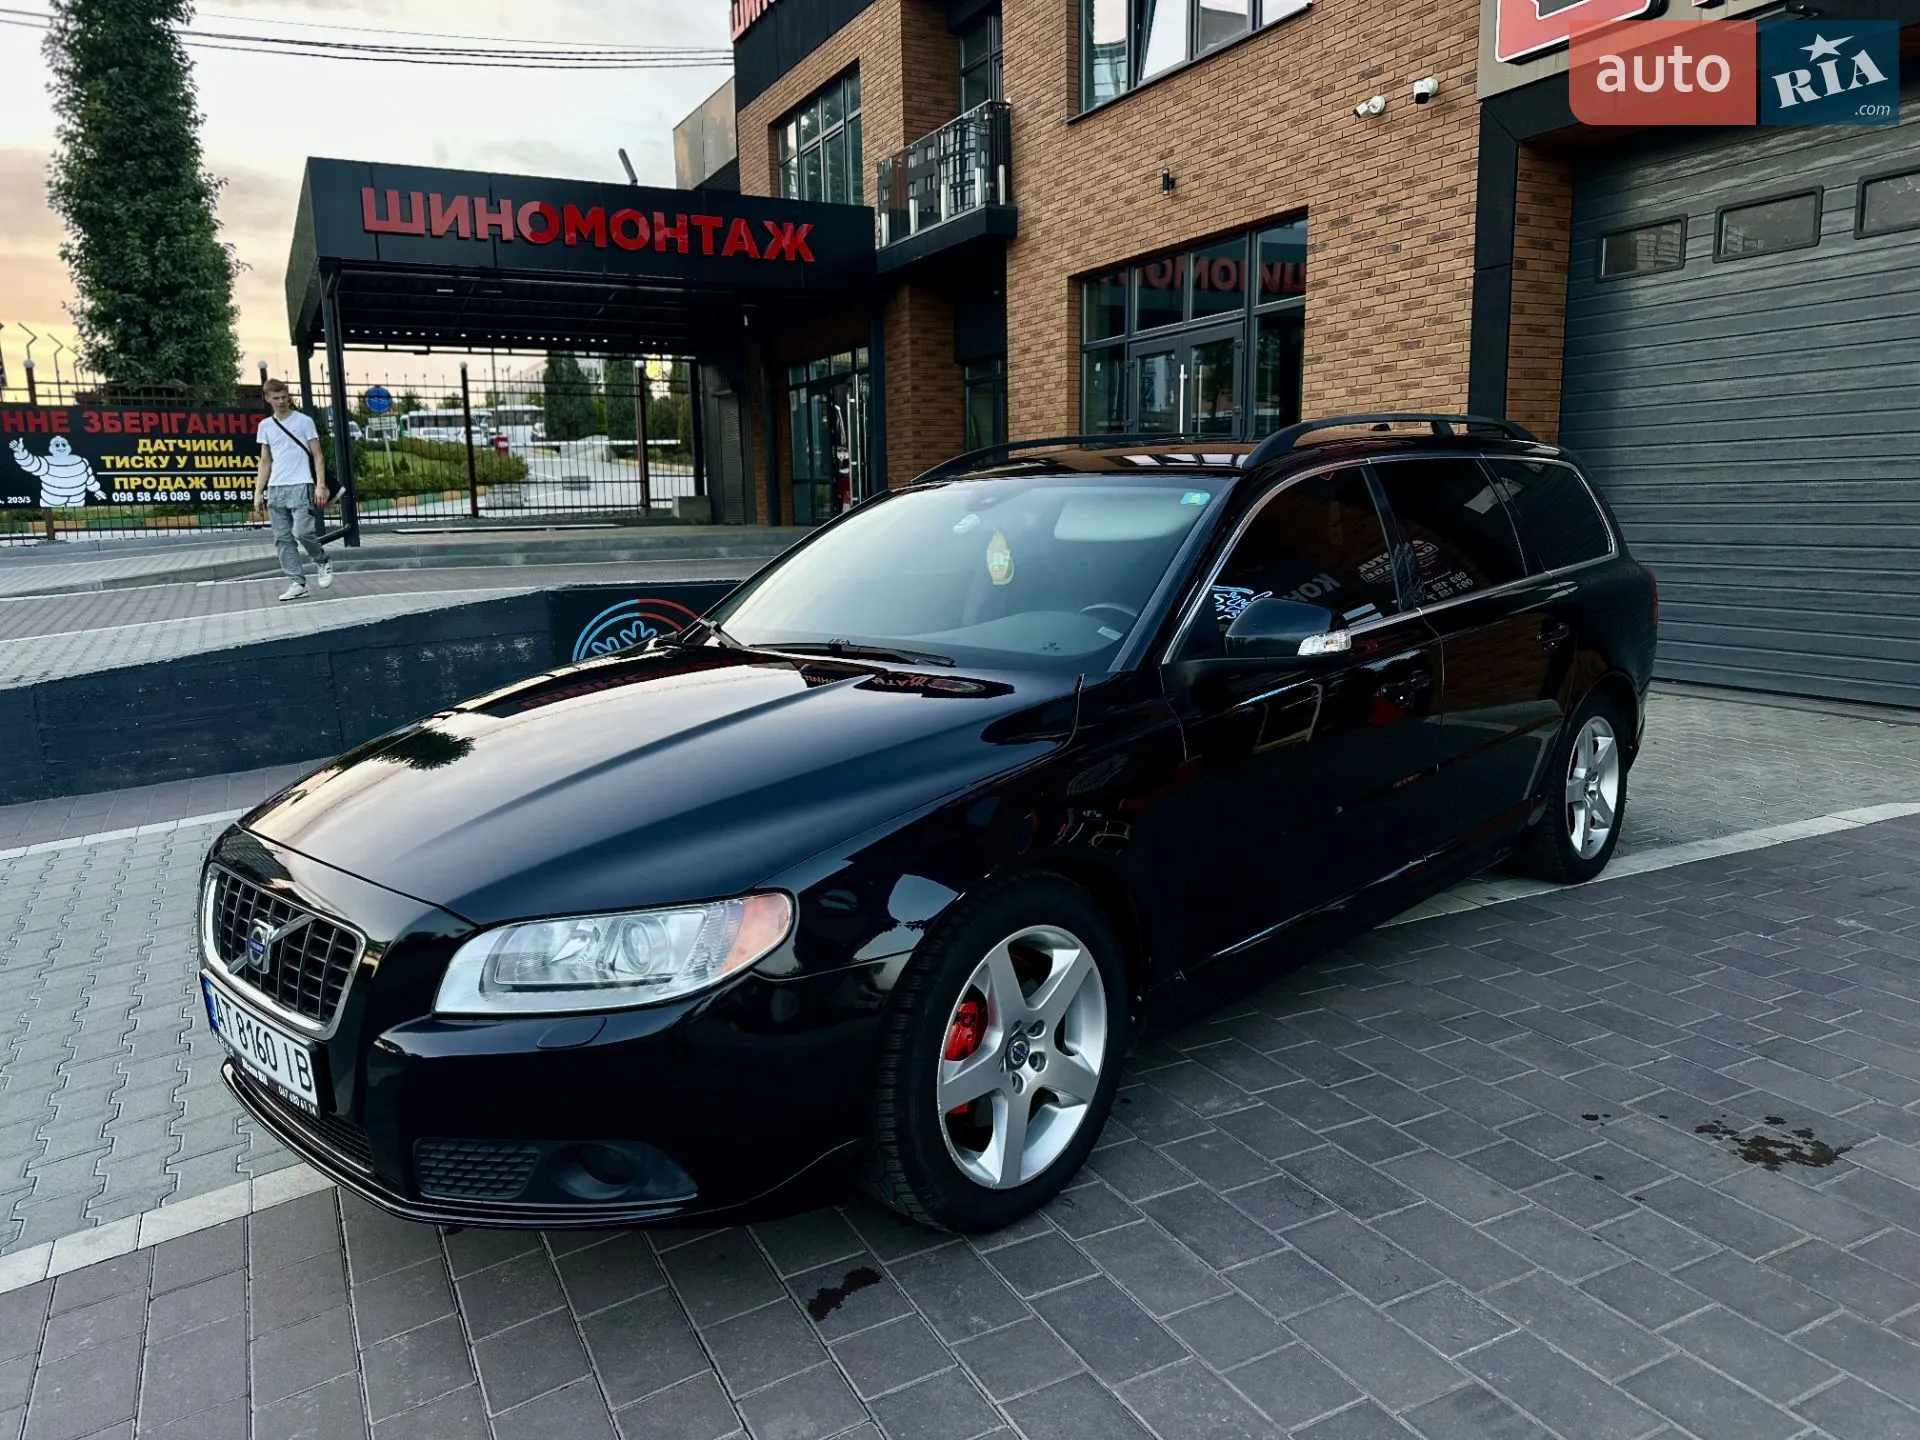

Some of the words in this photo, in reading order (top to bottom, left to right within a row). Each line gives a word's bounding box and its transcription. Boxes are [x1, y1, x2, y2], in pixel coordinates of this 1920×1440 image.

[361, 186, 816, 263] ШИНОМОНТАЖ
[2, 410, 70, 433] ННЕ
[83, 411, 267, 435] ЗБЕРІГАННЯ
[137, 438, 234, 454] ДАТЧИКИ
[100, 455, 170, 470] ТИСКУ
[176, 455, 188, 469] У
[114, 476, 207, 492] ПРОДАЖ
[7, 496, 31, 504] 203/3
[112, 492, 134, 502] 098
[137, 492, 151, 502] 58
[153, 492, 168, 502] 46
[170, 491, 191, 501] 089
[200, 491, 221, 501] 066
[224, 491, 238, 501] 56
[240, 491, 253, 501] 85
[215, 993, 235, 1040] AT
[236, 1009, 277, 1073] 8160
[284, 1042, 312, 1094] IB
